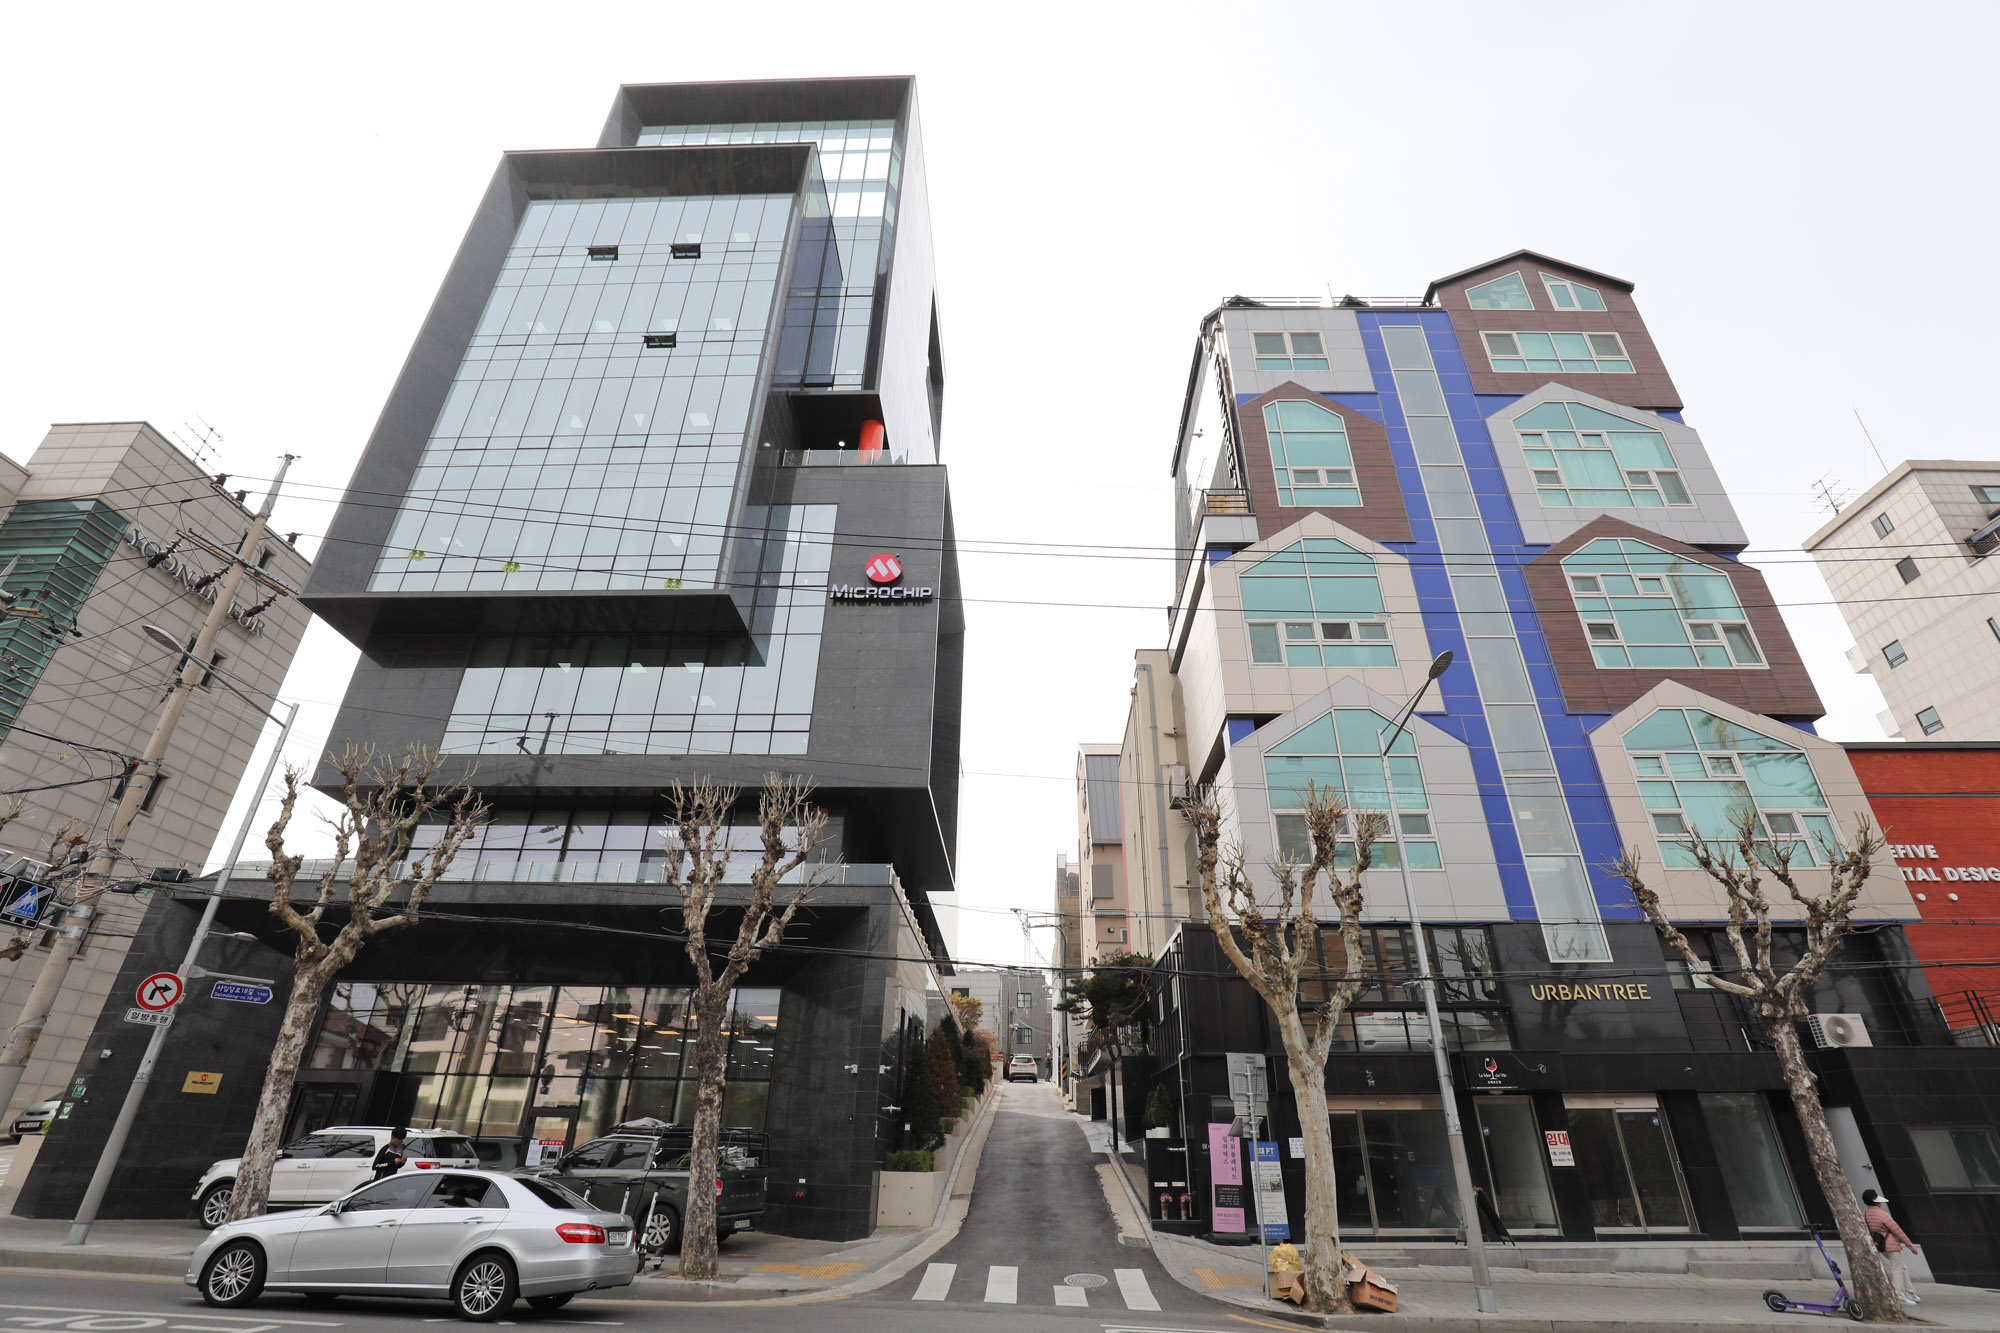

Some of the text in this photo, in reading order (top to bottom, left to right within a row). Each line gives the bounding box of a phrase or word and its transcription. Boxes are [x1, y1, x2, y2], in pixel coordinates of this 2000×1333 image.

[1530, 984, 1652, 1000] URBANTREE
[131, 1011, 169, 1024] 일방통행
[1546, 1133, 1570, 1146] 임대
